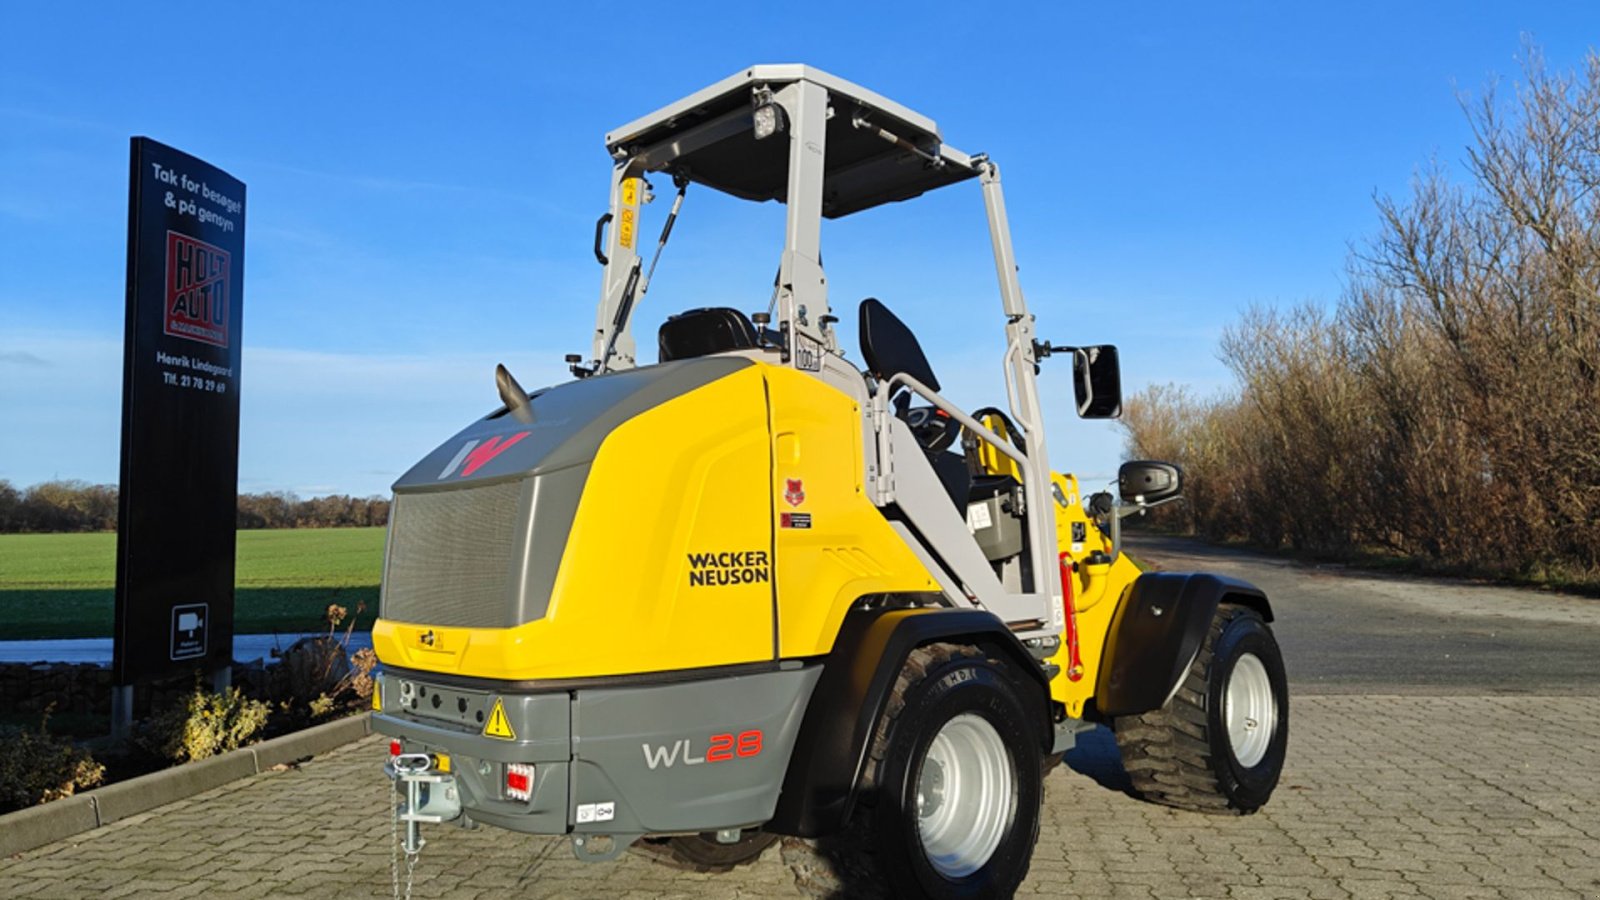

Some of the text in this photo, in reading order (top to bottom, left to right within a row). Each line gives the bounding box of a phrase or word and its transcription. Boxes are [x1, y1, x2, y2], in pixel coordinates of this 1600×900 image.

[152, 162, 242, 214] Tak for besøget
[164, 191, 234, 232] & på gensyn
[175, 239, 225, 290] HOLT
[171, 277, 225, 328] AUTO
[156, 351, 233, 377] Henrik Lindegaard
[180, 374, 192, 387] 21
[193, 376, 204, 390] 78
[205, 379, 215, 391] 29
[687, 551, 769, 569] WACKER
[689, 567, 769, 587] NEUSON
